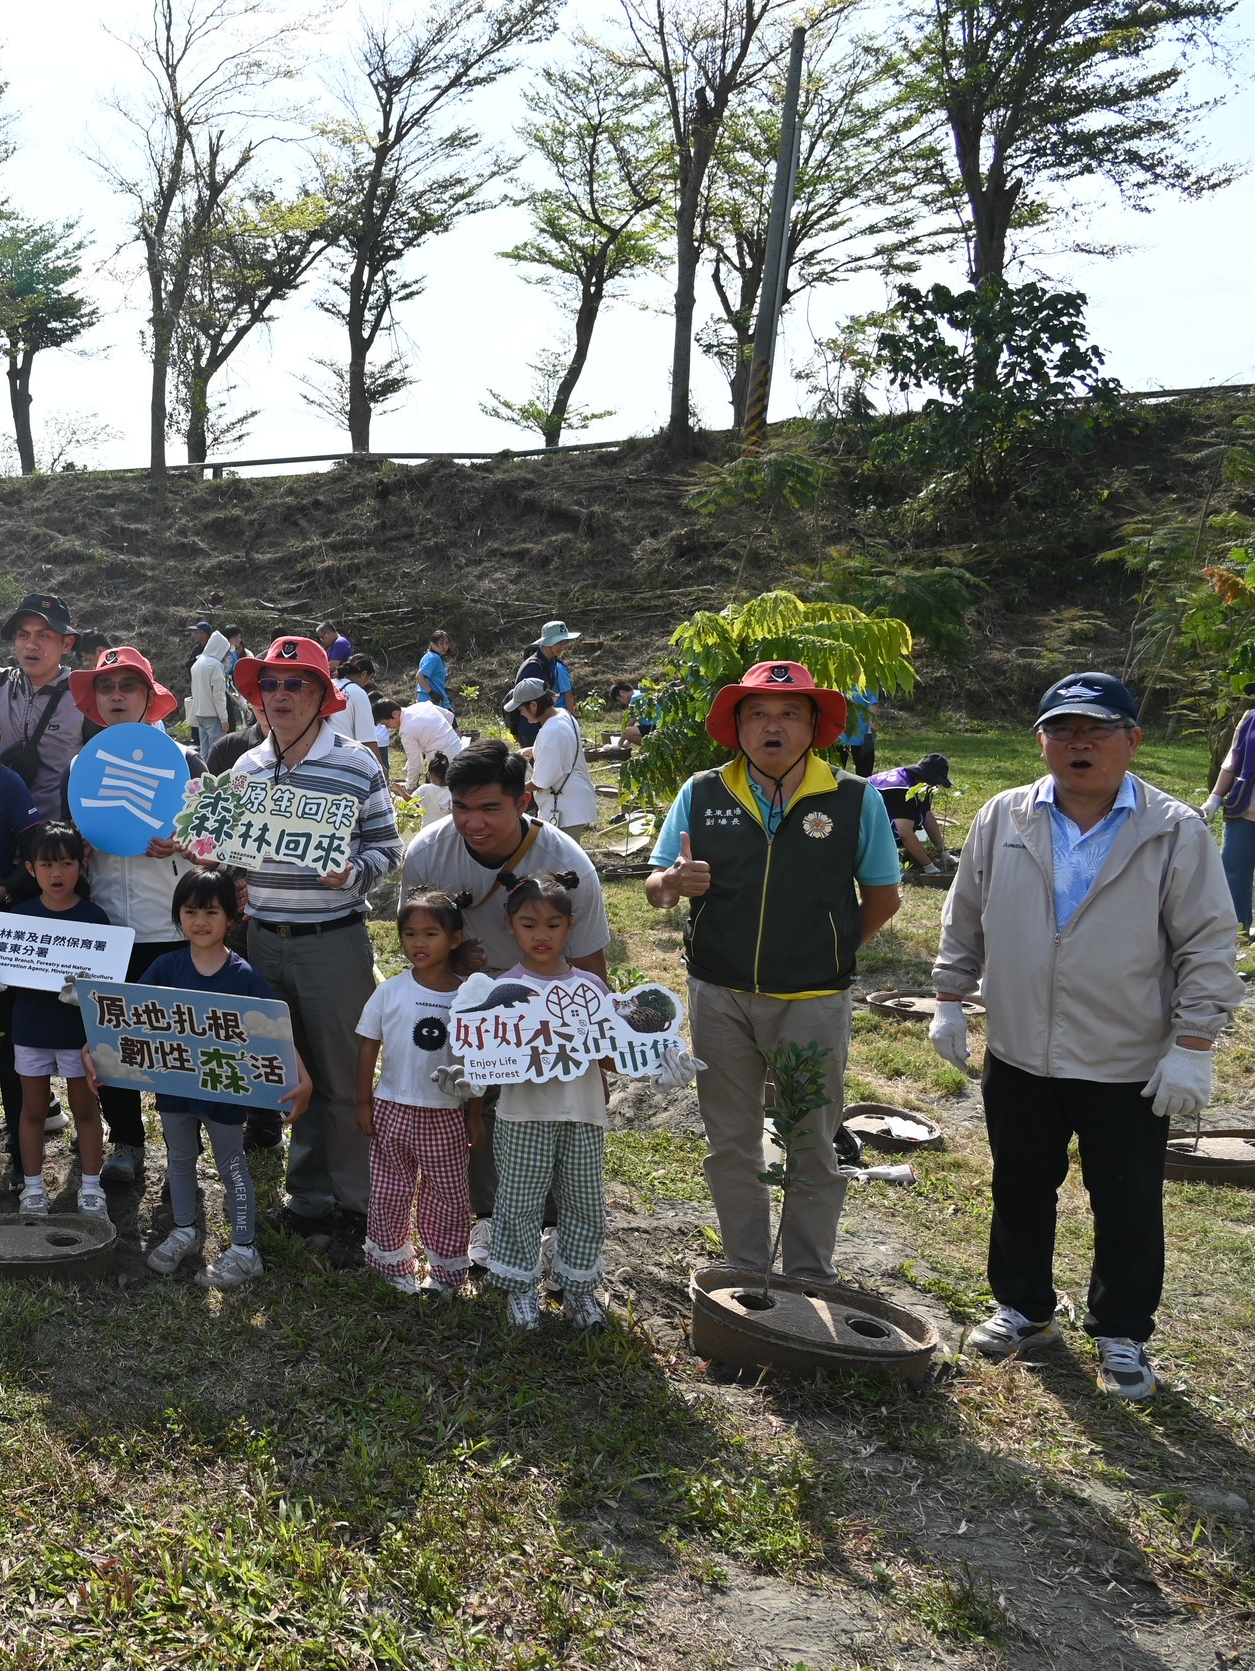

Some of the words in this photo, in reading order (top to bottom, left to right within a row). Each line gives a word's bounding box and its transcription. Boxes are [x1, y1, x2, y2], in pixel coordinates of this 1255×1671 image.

[240, 782, 355, 830] 原生回來
[190, 791, 347, 872] 森林回來
[0, 928, 107, 952] 林業及自然保育署
[14, 957, 35, 965] Branch,
[36, 960, 60, 968] Forestry
[27, 965, 50, 973] Agency,
[93, 994, 247, 1044] 原地扎根
[119, 1036, 285, 1094] 韌性森活
[468, 1071, 487, 1080] The
[489, 1070, 520, 1079] Forest
[469, 1058, 497, 1069] Enjoy
[499, 1056, 517, 1066] Life
[230, 1155, 247, 1201] SUMMER
[236, 1204, 247, 1232] TIME
